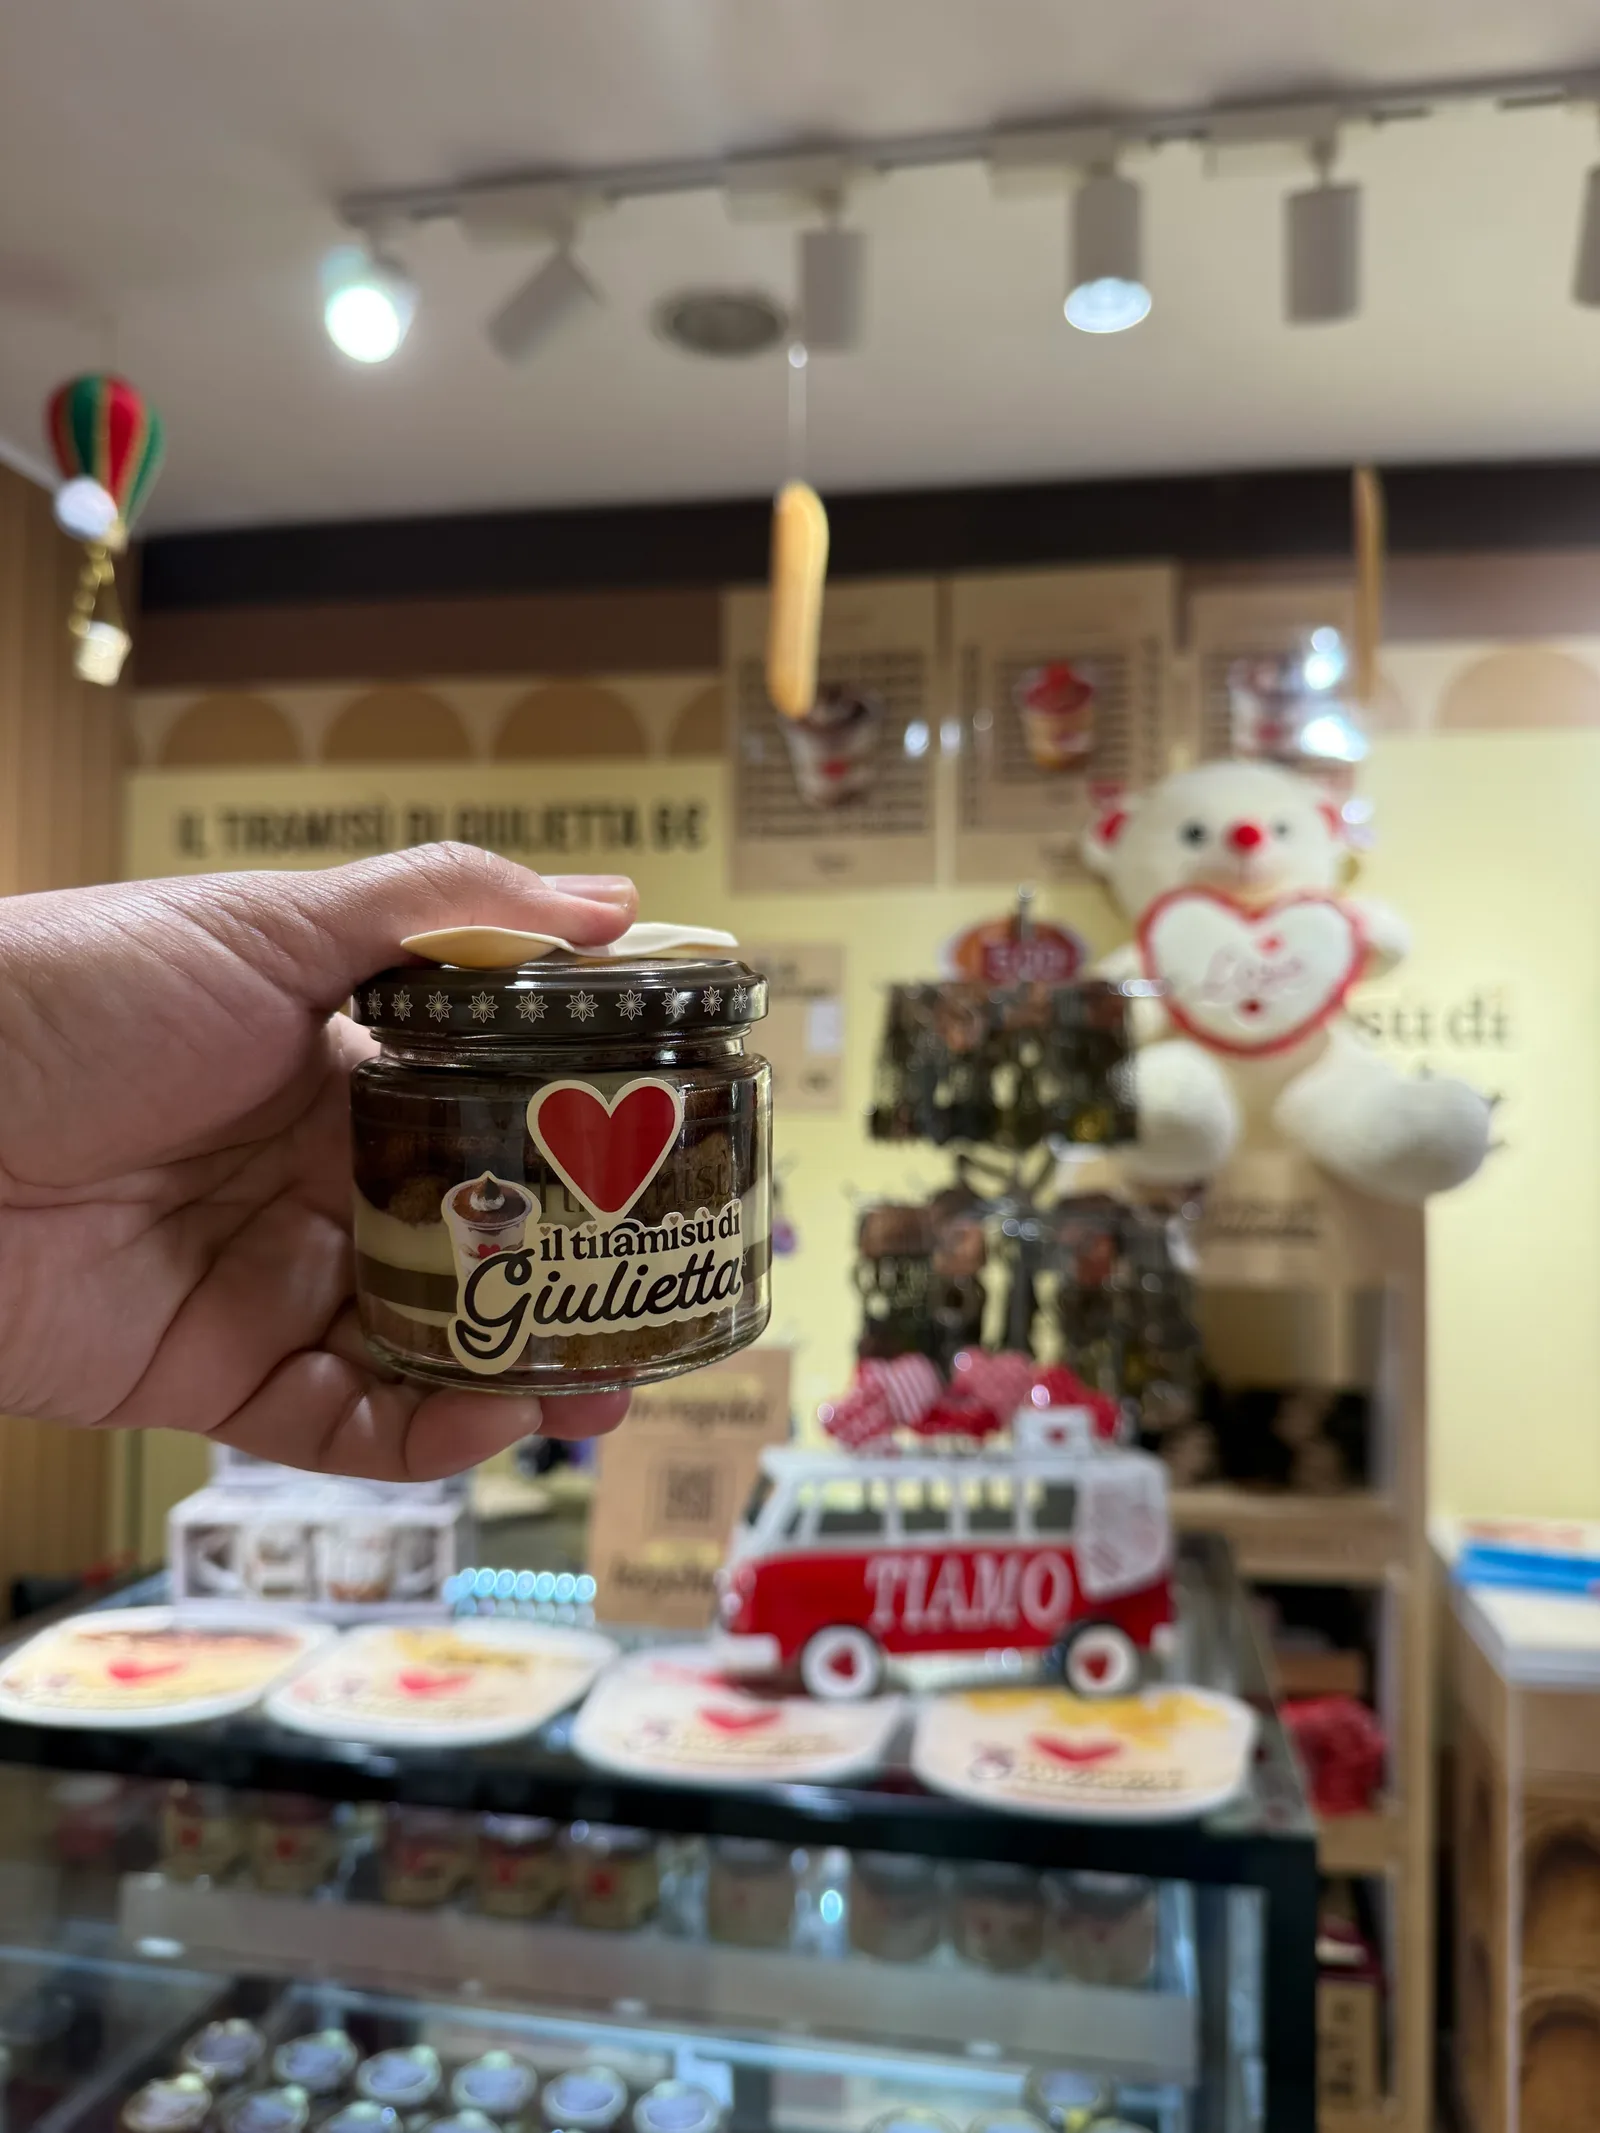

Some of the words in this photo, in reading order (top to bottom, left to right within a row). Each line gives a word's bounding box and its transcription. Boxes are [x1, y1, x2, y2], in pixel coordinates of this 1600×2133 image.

[540, 1226, 564, 1261] il
[570, 1209, 715, 1260] tiramisù
[719, 1201, 741, 1237] di
[455, 1249, 742, 1360] Giulietta
[864, 1553, 1074, 1634] TIAMO
